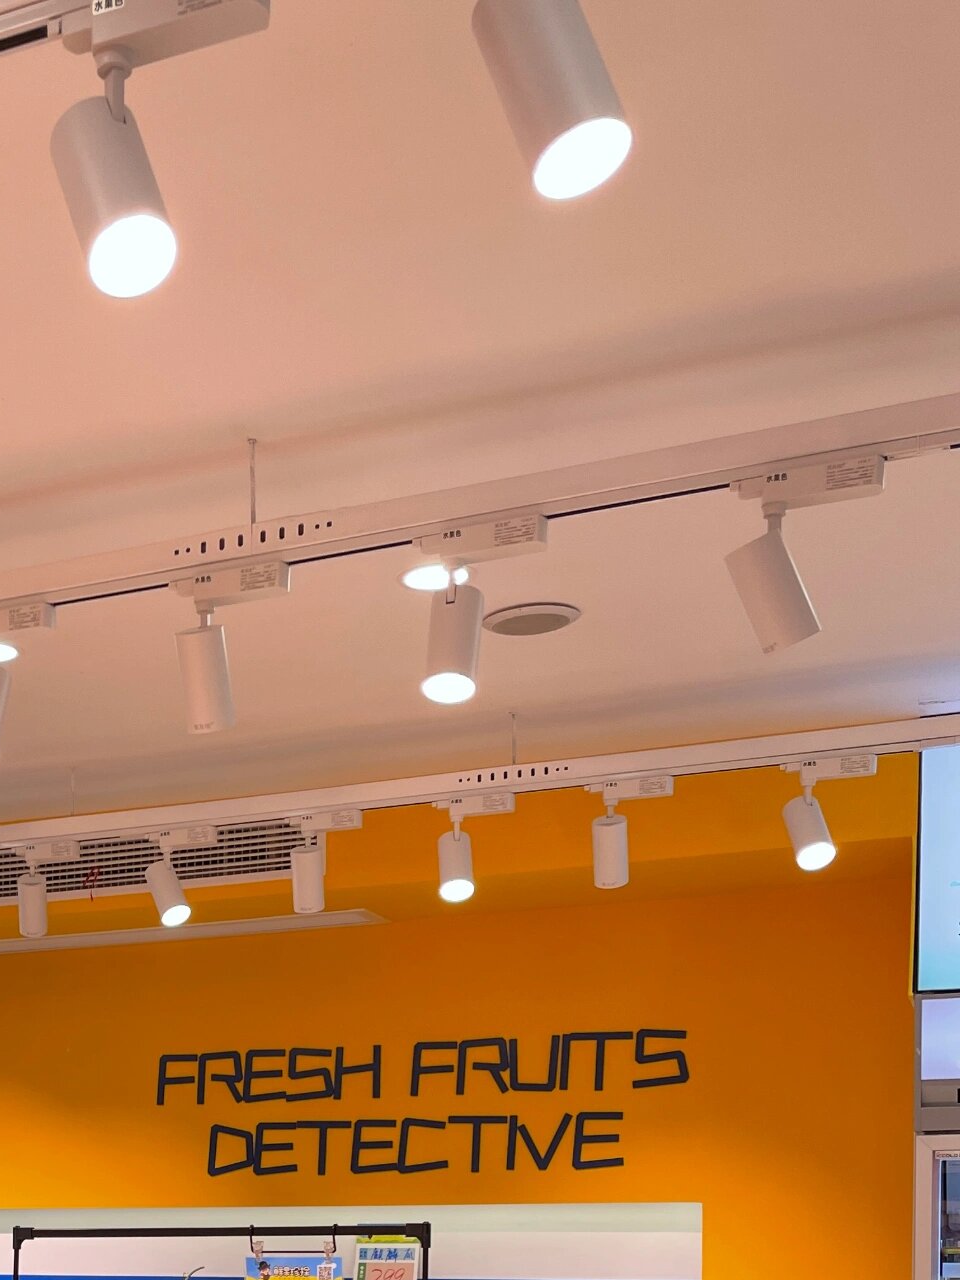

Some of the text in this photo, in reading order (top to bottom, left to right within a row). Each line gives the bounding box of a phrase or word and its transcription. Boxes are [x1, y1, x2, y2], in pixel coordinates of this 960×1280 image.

[156, 1028, 690, 1106] FRESH FRUITS
[207, 1111, 624, 1177] DETECTIVE
